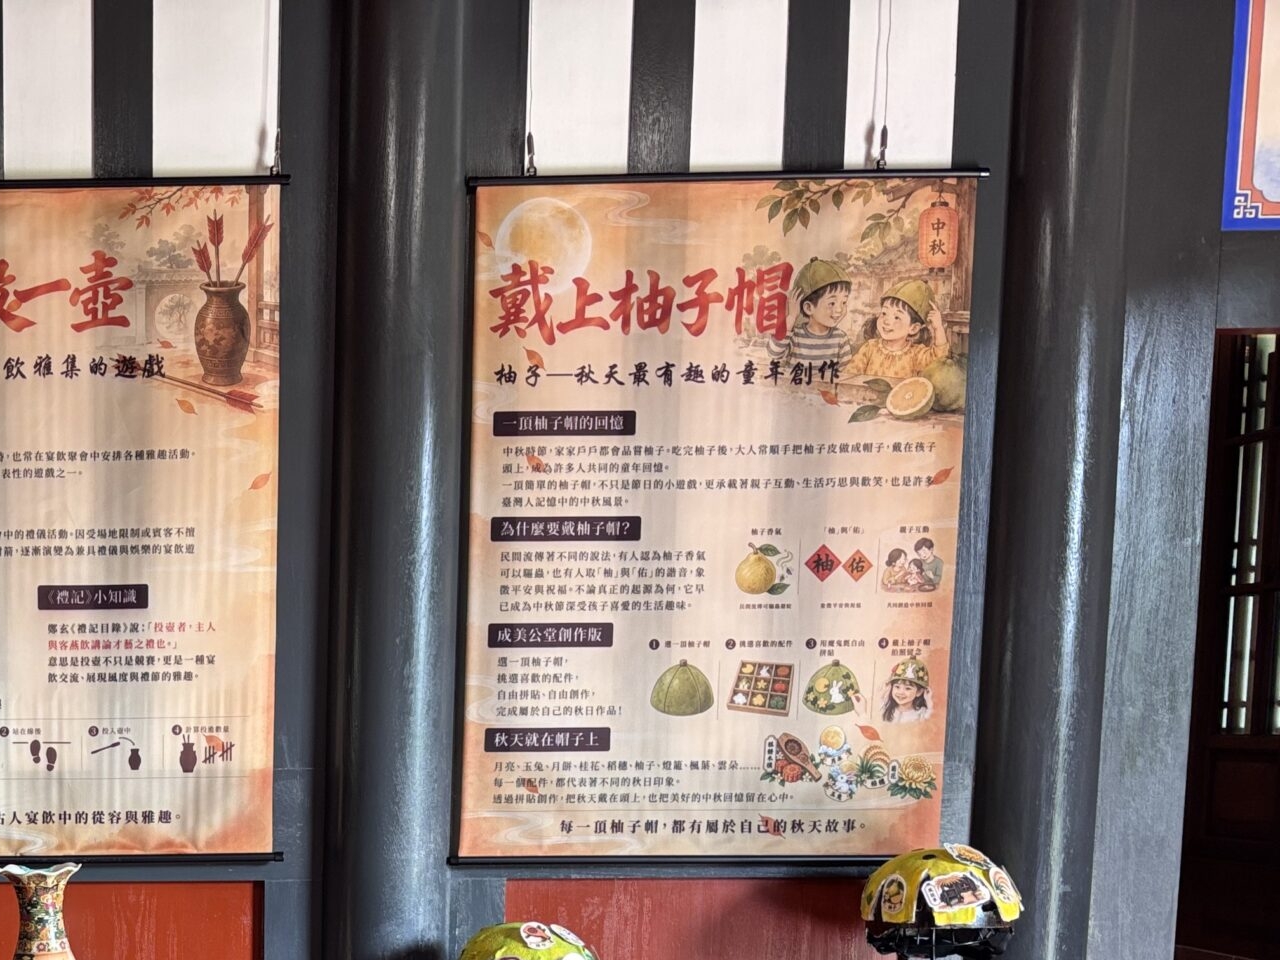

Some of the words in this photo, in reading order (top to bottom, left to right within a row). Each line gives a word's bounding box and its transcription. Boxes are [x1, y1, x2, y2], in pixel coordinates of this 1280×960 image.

[928, 217, 947, 256] 中秋
[489, 259, 794, 346] 戴上柚子帽
[502, 416, 625, 431] 一頂柚子帽的回憶
[502, 462, 670, 474] 頭上，成為許多人共同的童年回憶。
[502, 496, 629, 508] 臺灣人記憶中的中秋風景。
[501, 521, 631, 537] 為什麼要戴柚子帽？
[751, 527, 783, 537] 柚子香氣
[899, 525, 930, 534] 親子互動
[500, 550, 707, 562] 民間流傳著不同的說法，有人認為柚子香氣
[813, 553, 835, 574] 柚
[848, 556, 865, 573] 佑
[500, 567, 705, 579] 可以驅蟲，也有人取「柚」與「佑」的諧音，象
[499, 584, 705, 596] 徵平安與祝福。不論真正的起源為何，它早
[47, 589, 137, 606] 《禮記》小知識
[499, 600, 693, 612] 已成為中秋節深受孩子喜愛的生活趣味。
[497, 627, 602, 643] 成美公堂創作版
[664, 640, 711, 649] 選一頂柚子帽
[739, 639, 793, 648] 挑選喜歡的配件
[891, 638, 931, 647] 戴上柚子帽
[48, 655, 216, 667] 意思是投壺不只是競賽，更是一種宴
[497, 656, 569, 668] 選一頂柚子帽，
[48, 671, 199, 684] 飲交流、展現風度與禮節的雅趣。
[497, 673, 580, 684] 挑選喜歡的配件，
[497, 689, 596, 701] 自由拼貼、自由創作，
[496, 706, 623, 717] 完成屬於自己的秋日作品！
[12, 727, 42, 736] 站在線後
[493, 732, 600, 747] 秋天就在帽子上
[493, 776, 681, 788] 每一個配件，都代表著不同的秋日印象。
[492, 790, 795, 805] 透過拼貼創作，把秋天戴在頭上，也把美好的中秋回憶留在心中。
[559, 818, 866, 835] 每一頂柚子帽，都有屬於自己的秋天故事。
